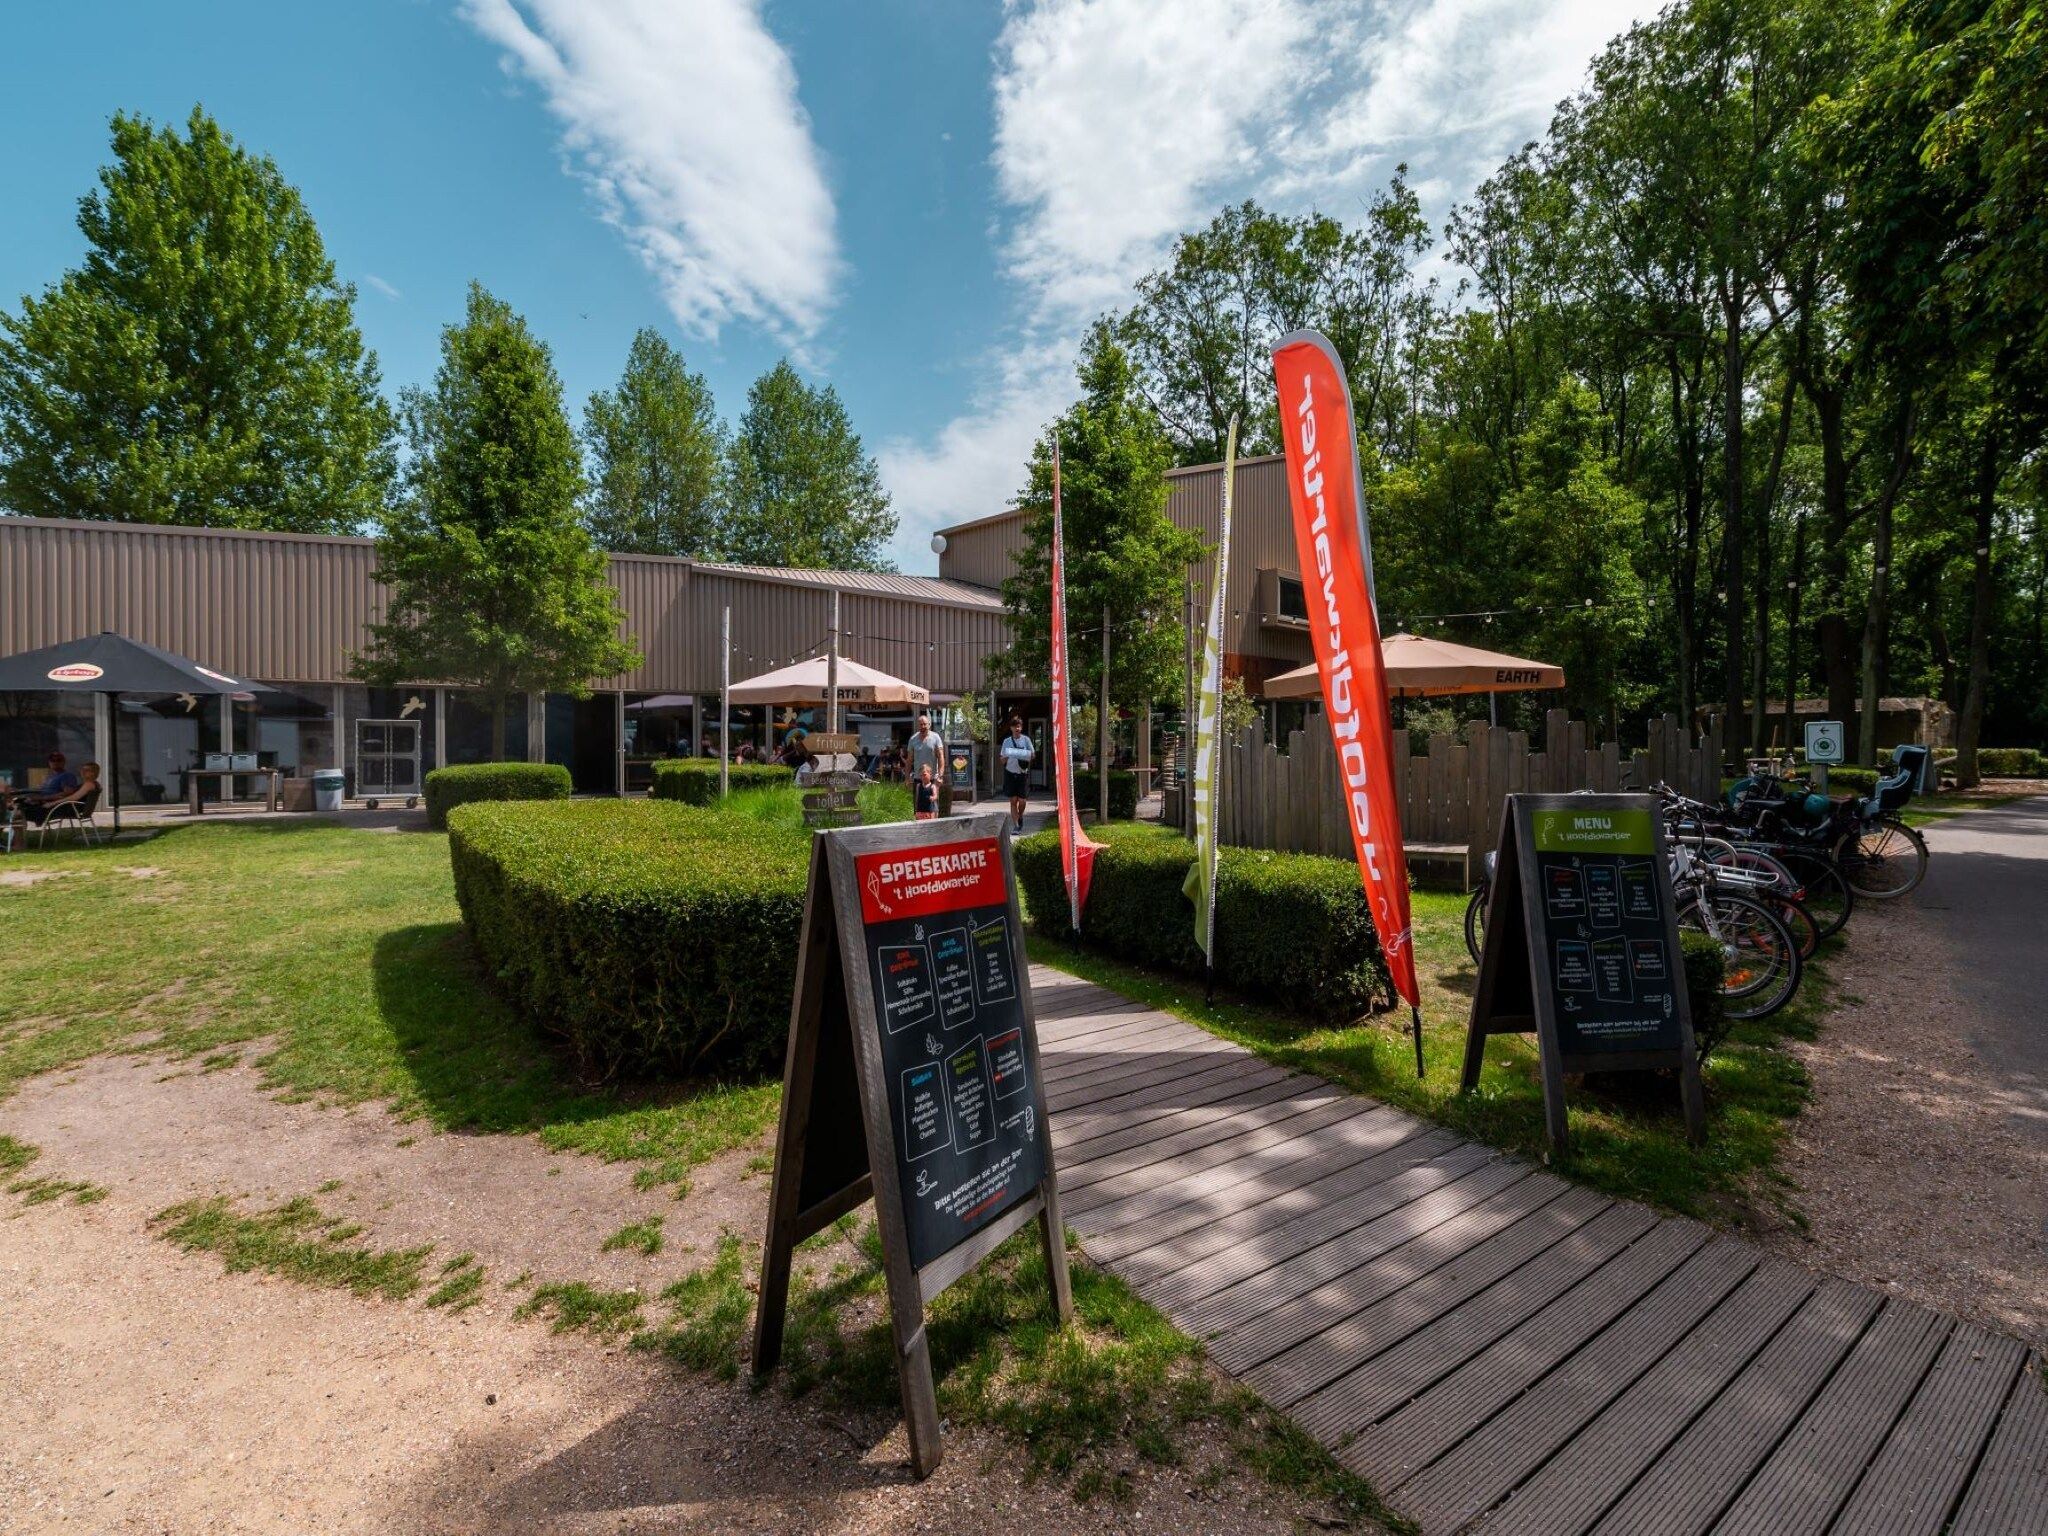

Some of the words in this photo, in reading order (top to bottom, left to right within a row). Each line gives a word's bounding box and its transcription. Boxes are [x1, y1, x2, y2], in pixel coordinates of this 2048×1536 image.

[1496, 670, 1541, 683] EARTH
[822, 689, 859, 698] ERTH
[1573, 818, 1612, 830] MENU
[880, 850, 987, 884] SPEISEKARTE
[893, 888, 903, 900] 't
[905, 874, 980, 899] Hoofdkwartier
